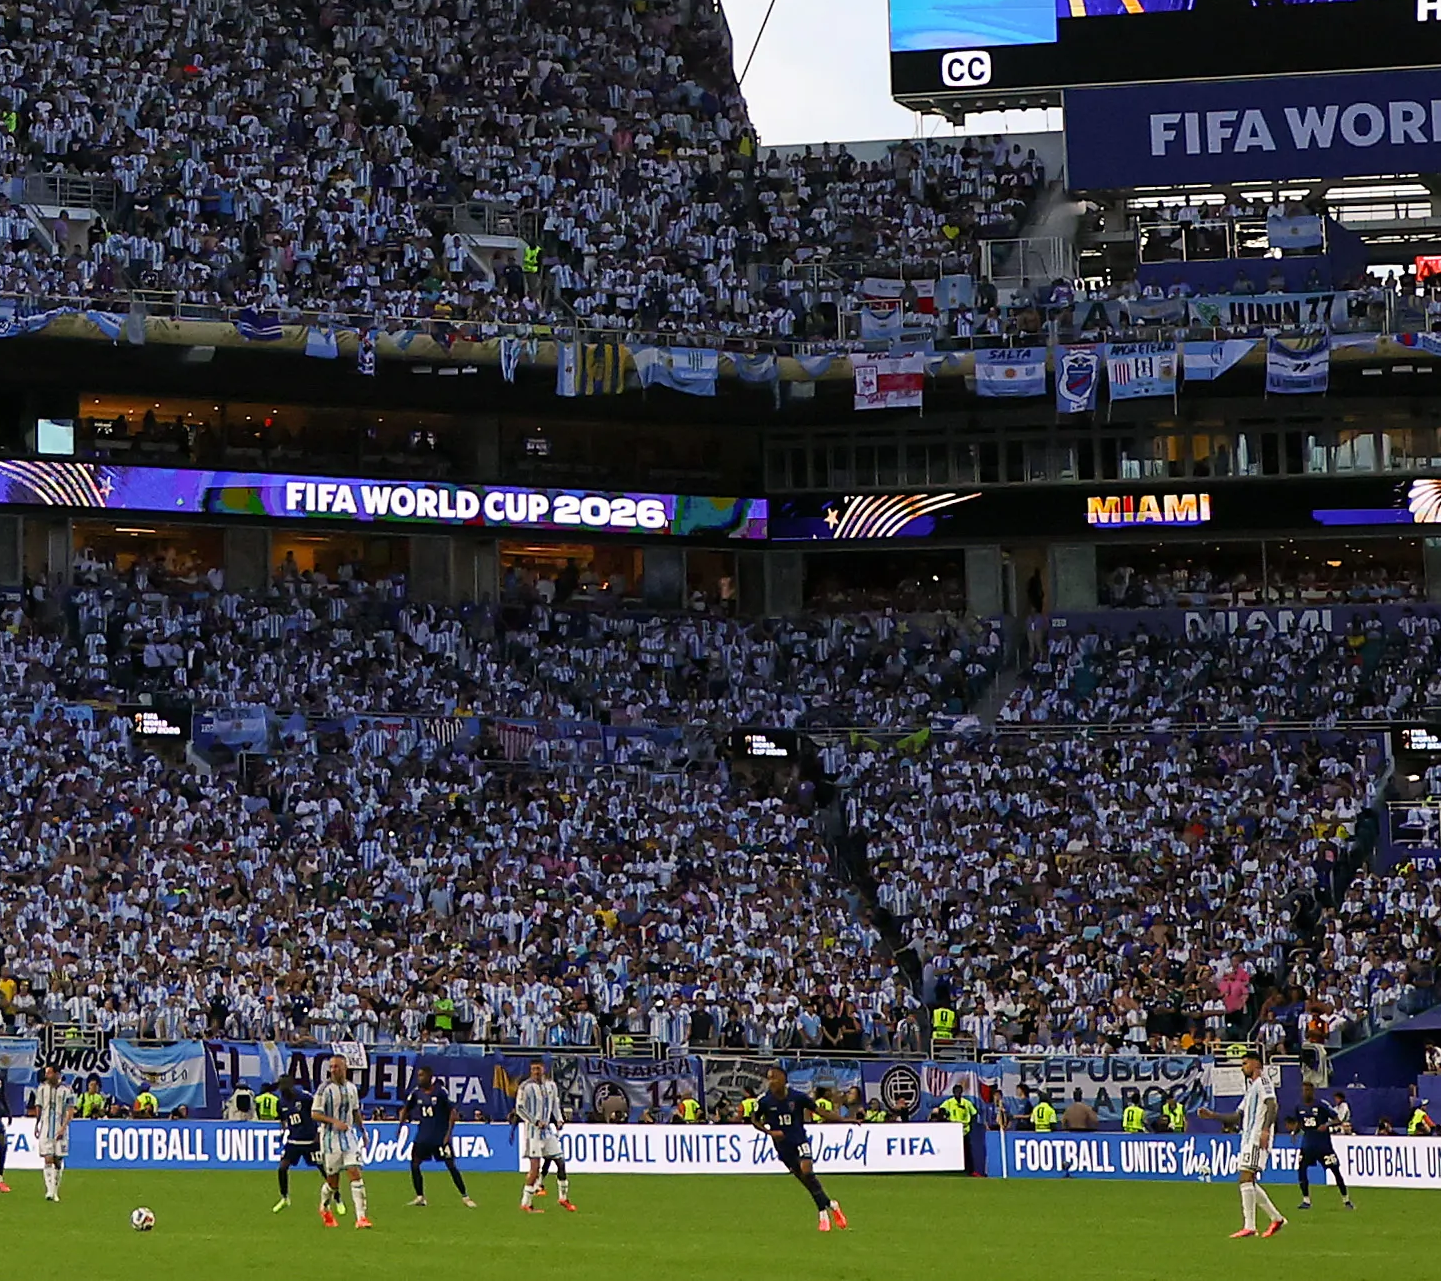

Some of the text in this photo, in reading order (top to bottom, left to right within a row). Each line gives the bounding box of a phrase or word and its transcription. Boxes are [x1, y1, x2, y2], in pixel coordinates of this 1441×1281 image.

[947, 57, 987, 82] CC
[1149, 107, 1279, 157] FIFA
[988, 348, 1032, 360] SALTA
[286, 481, 667, 529] FIFA WORLD CUP 2026
[1087, 493, 1211, 524] MIAMI
[35, 1047, 113, 1074] SOMOS
[1019, 1056, 1204, 1084] REPUBLICA
[646, 1080, 681, 1107] 14
[288, 1113, 302, 1127] 10
[420, 1106, 434, 1118] 14
[1302, 1116, 1317, 1129] 26
[95, 1127, 285, 1163] FOOTBALL UNITE
[439, 1144, 453, 1157] 14
[561, 1134, 934, 1164] OOTBALL UNITES FIFA
[1015, 1138, 1114, 1174] FOOTBALL
[1120, 1141, 1177, 1174] UNITES
[1324, 1153, 1339, 1166] 26
[1347, 1145, 1422, 1179] FOOTBALL
